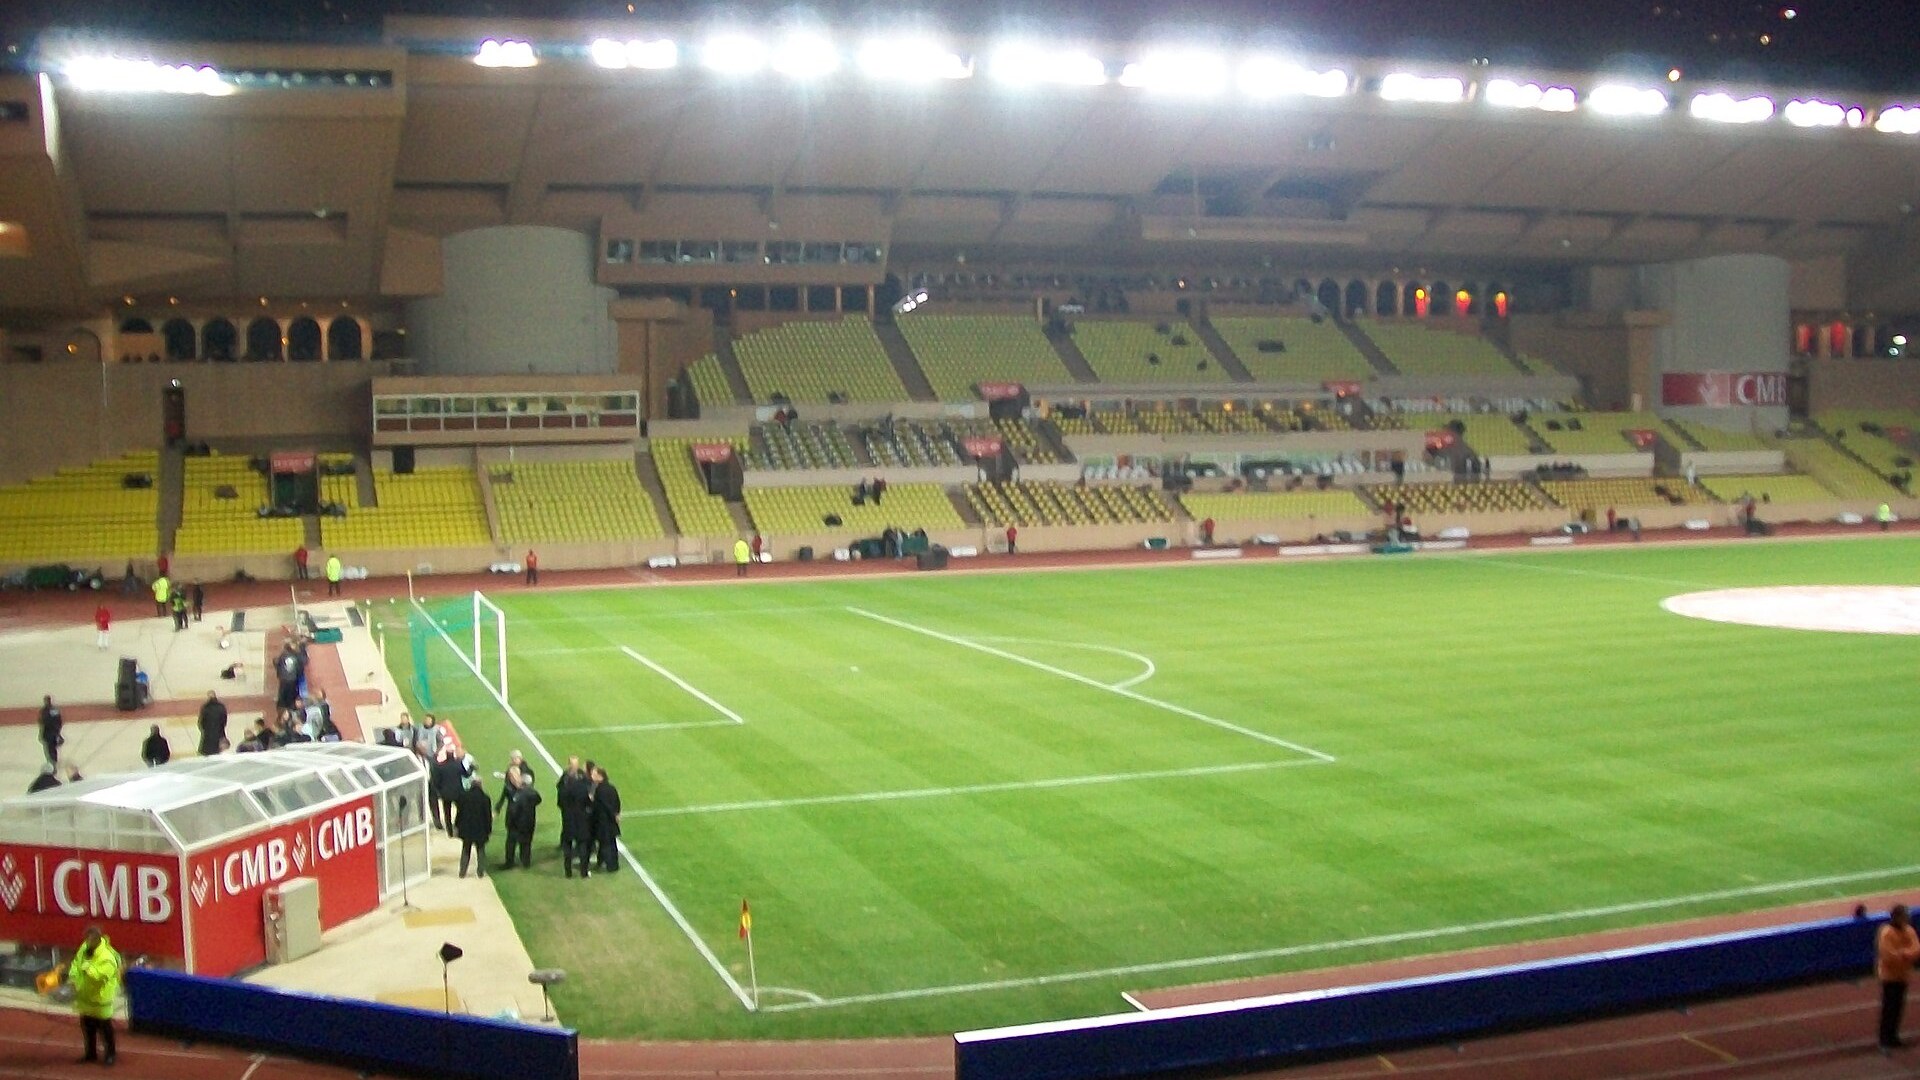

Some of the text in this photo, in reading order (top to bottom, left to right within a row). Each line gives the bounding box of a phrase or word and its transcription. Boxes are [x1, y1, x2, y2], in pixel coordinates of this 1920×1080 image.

[318, 806, 374, 860] CMB
[53, 859, 171, 923] CMB
[223, 838, 288, 896] CMB
